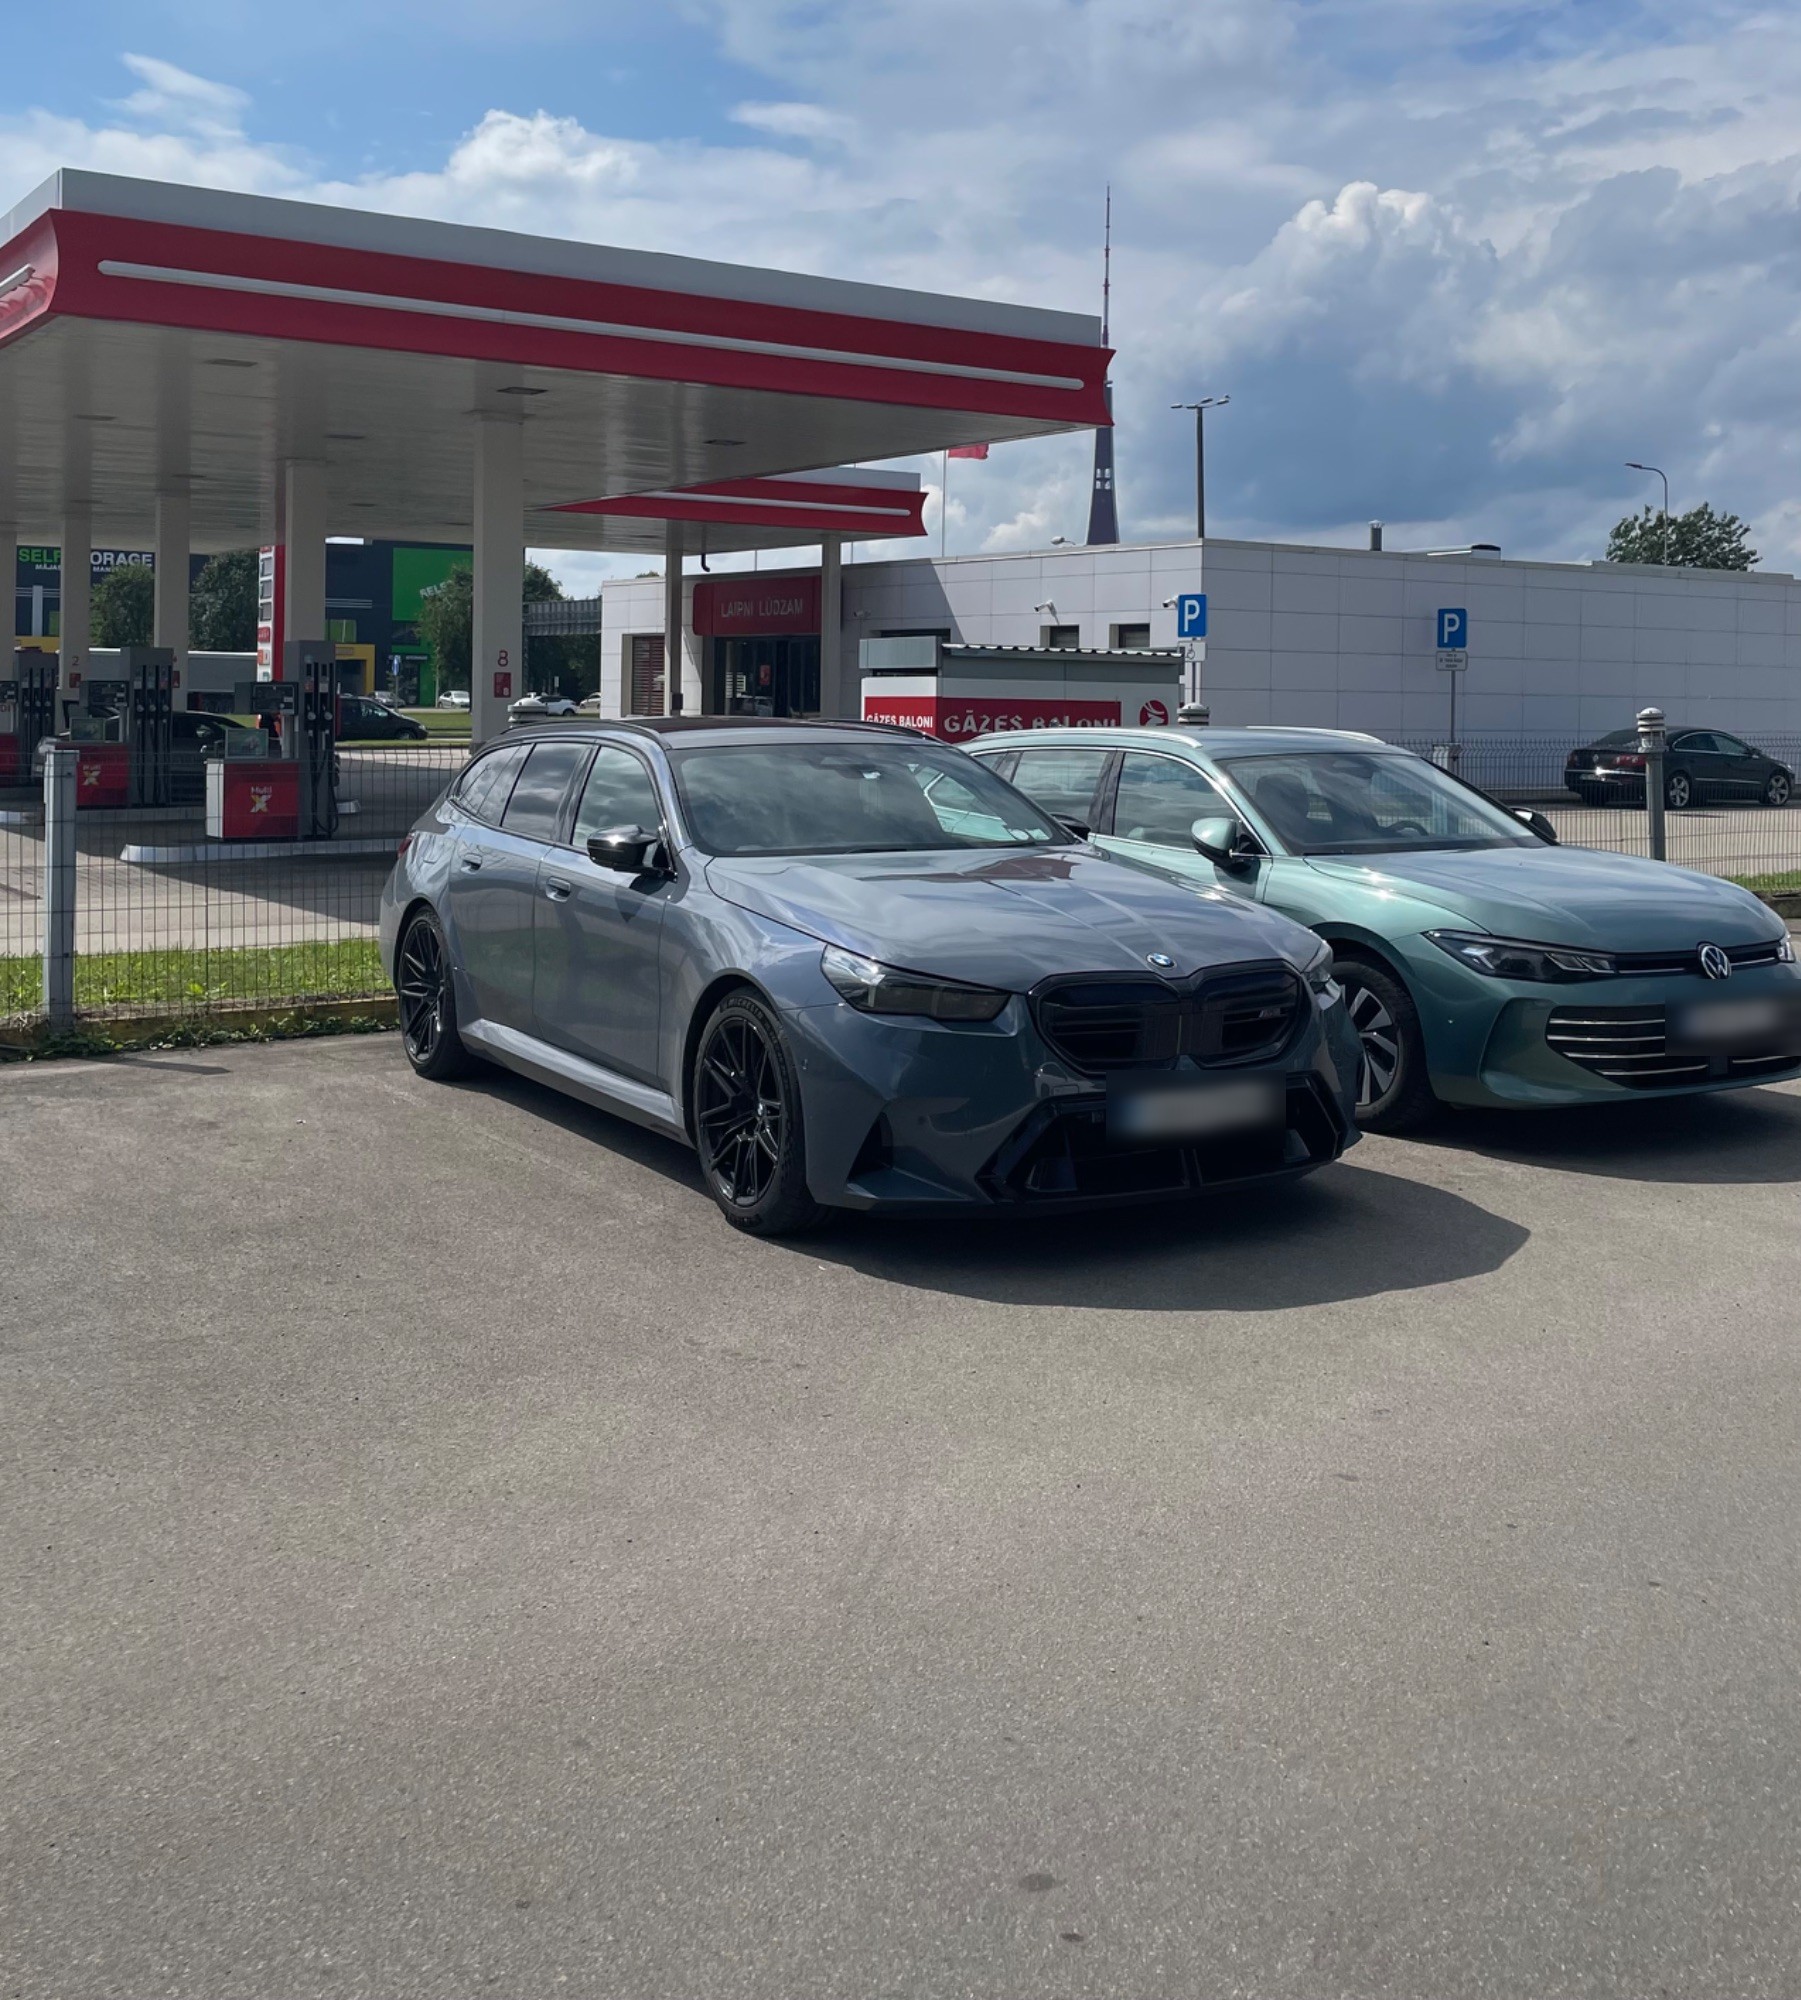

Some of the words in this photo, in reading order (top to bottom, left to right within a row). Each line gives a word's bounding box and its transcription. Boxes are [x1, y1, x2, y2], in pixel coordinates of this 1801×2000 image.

[91, 551, 153, 568] ORAGE
[721, 601, 753, 618] LAIPNI
[1184, 600, 1200, 632] P
[1443, 613, 1460, 643] P
[72, 656, 79, 666] 2
[498, 650, 508, 667] 8
[899, 716, 933, 728] BALONI
[944, 710, 1023, 733] GĀZES
